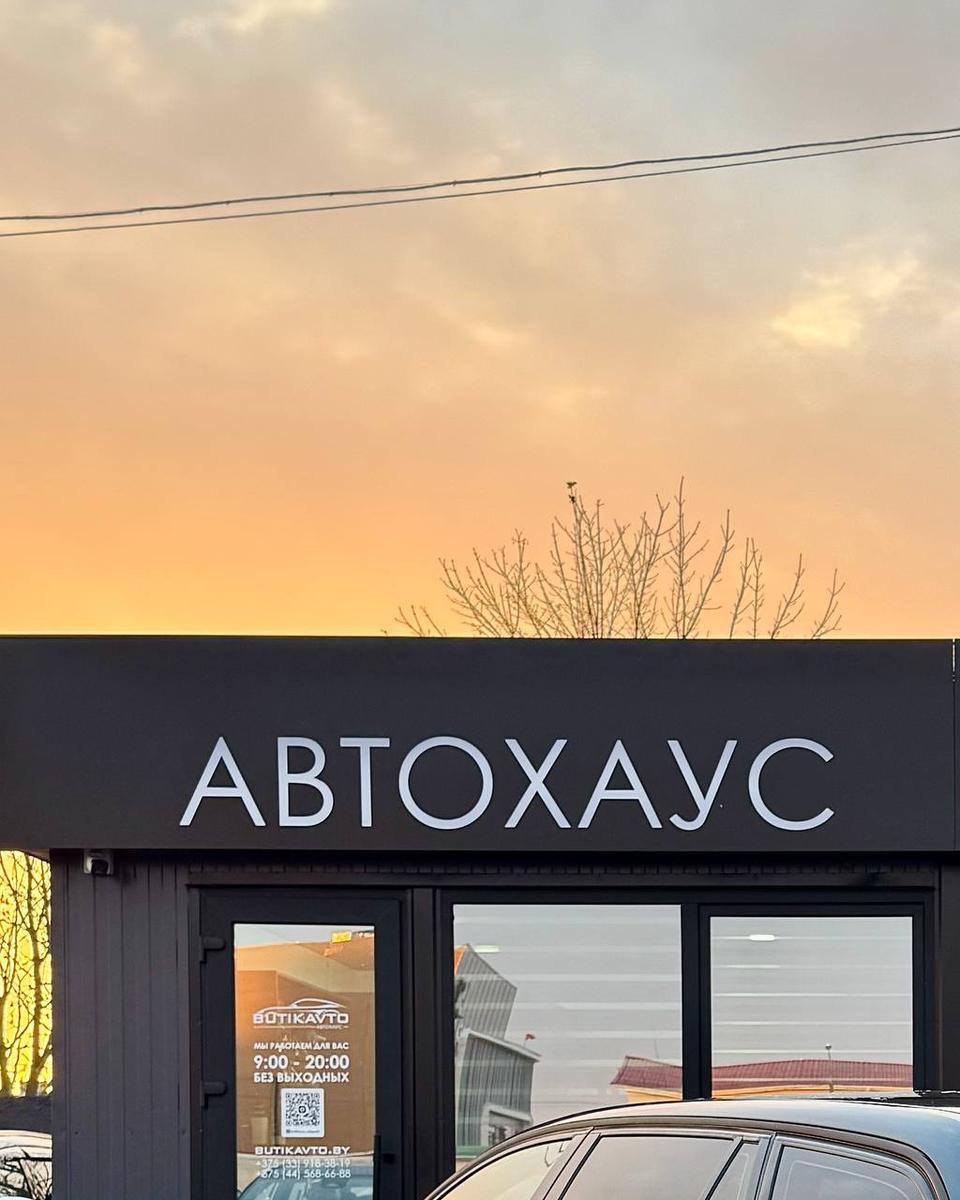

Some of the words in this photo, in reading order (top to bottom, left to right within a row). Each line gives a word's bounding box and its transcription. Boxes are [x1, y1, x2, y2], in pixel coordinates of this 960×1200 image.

[180, 735, 836, 832] АВТОХАУС
[252, 1012, 350, 1024] BUTIKAVTO
[253, 1042, 269, 1050] МЫ
[269, 1042, 312, 1050] РАБОТАЕМ
[313, 1042, 331, 1050] ДЛЯ
[332, 1042, 350, 1050] ВАС
[253, 1054, 289, 1069] 9:00
[304, 1054, 350, 1069] 20:00
[253, 1072, 274, 1082] БЕЗ
[276, 1072, 350, 1083] ВЫХОДНЫХ
[254, 1146, 351, 1155] BUTIKAVTO.BY
[282, 1168, 300, 1180] (44)
[303, 1168, 352, 1178] 568-66-88
